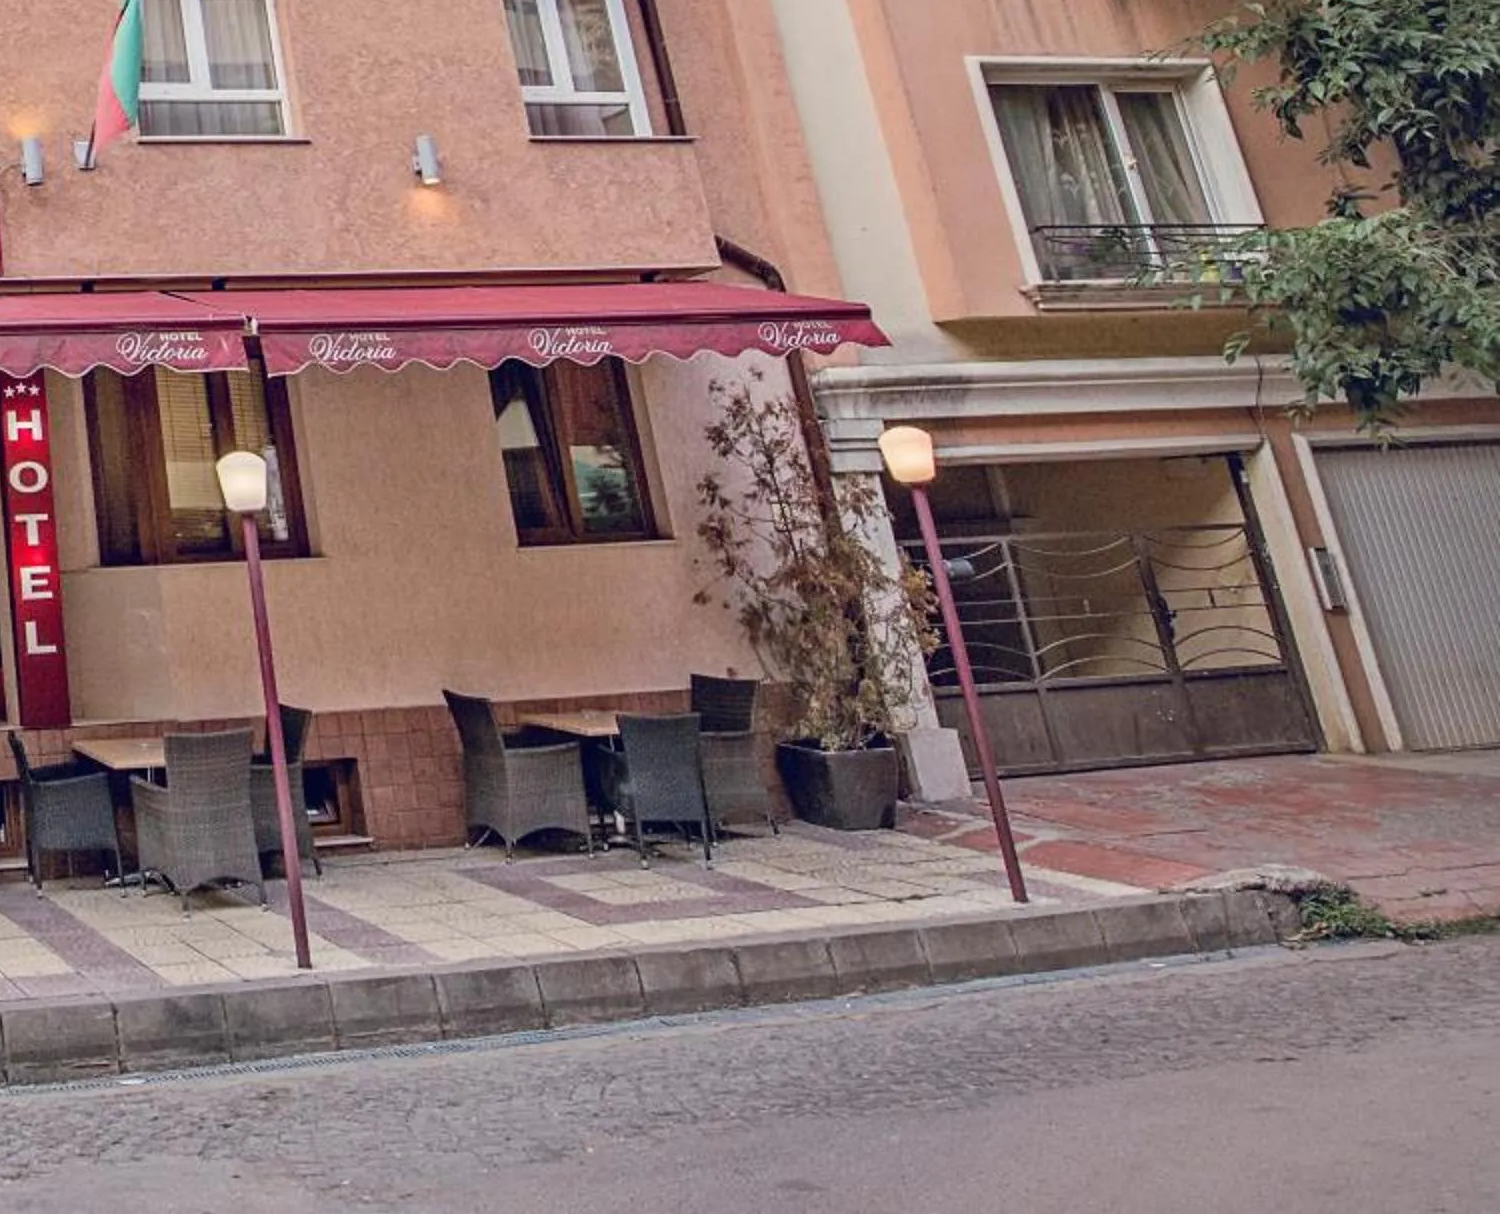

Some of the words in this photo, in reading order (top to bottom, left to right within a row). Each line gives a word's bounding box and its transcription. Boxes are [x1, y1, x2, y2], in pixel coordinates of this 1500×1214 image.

[116, 332, 208, 364] Victoria
[160, 332, 203, 341] HOTEL
[309, 333, 396, 364] Victoria
[527, 328, 612, 358] Victoria
[758, 322, 842, 350] Victoria
[7, 409, 57, 655] HOTEL
